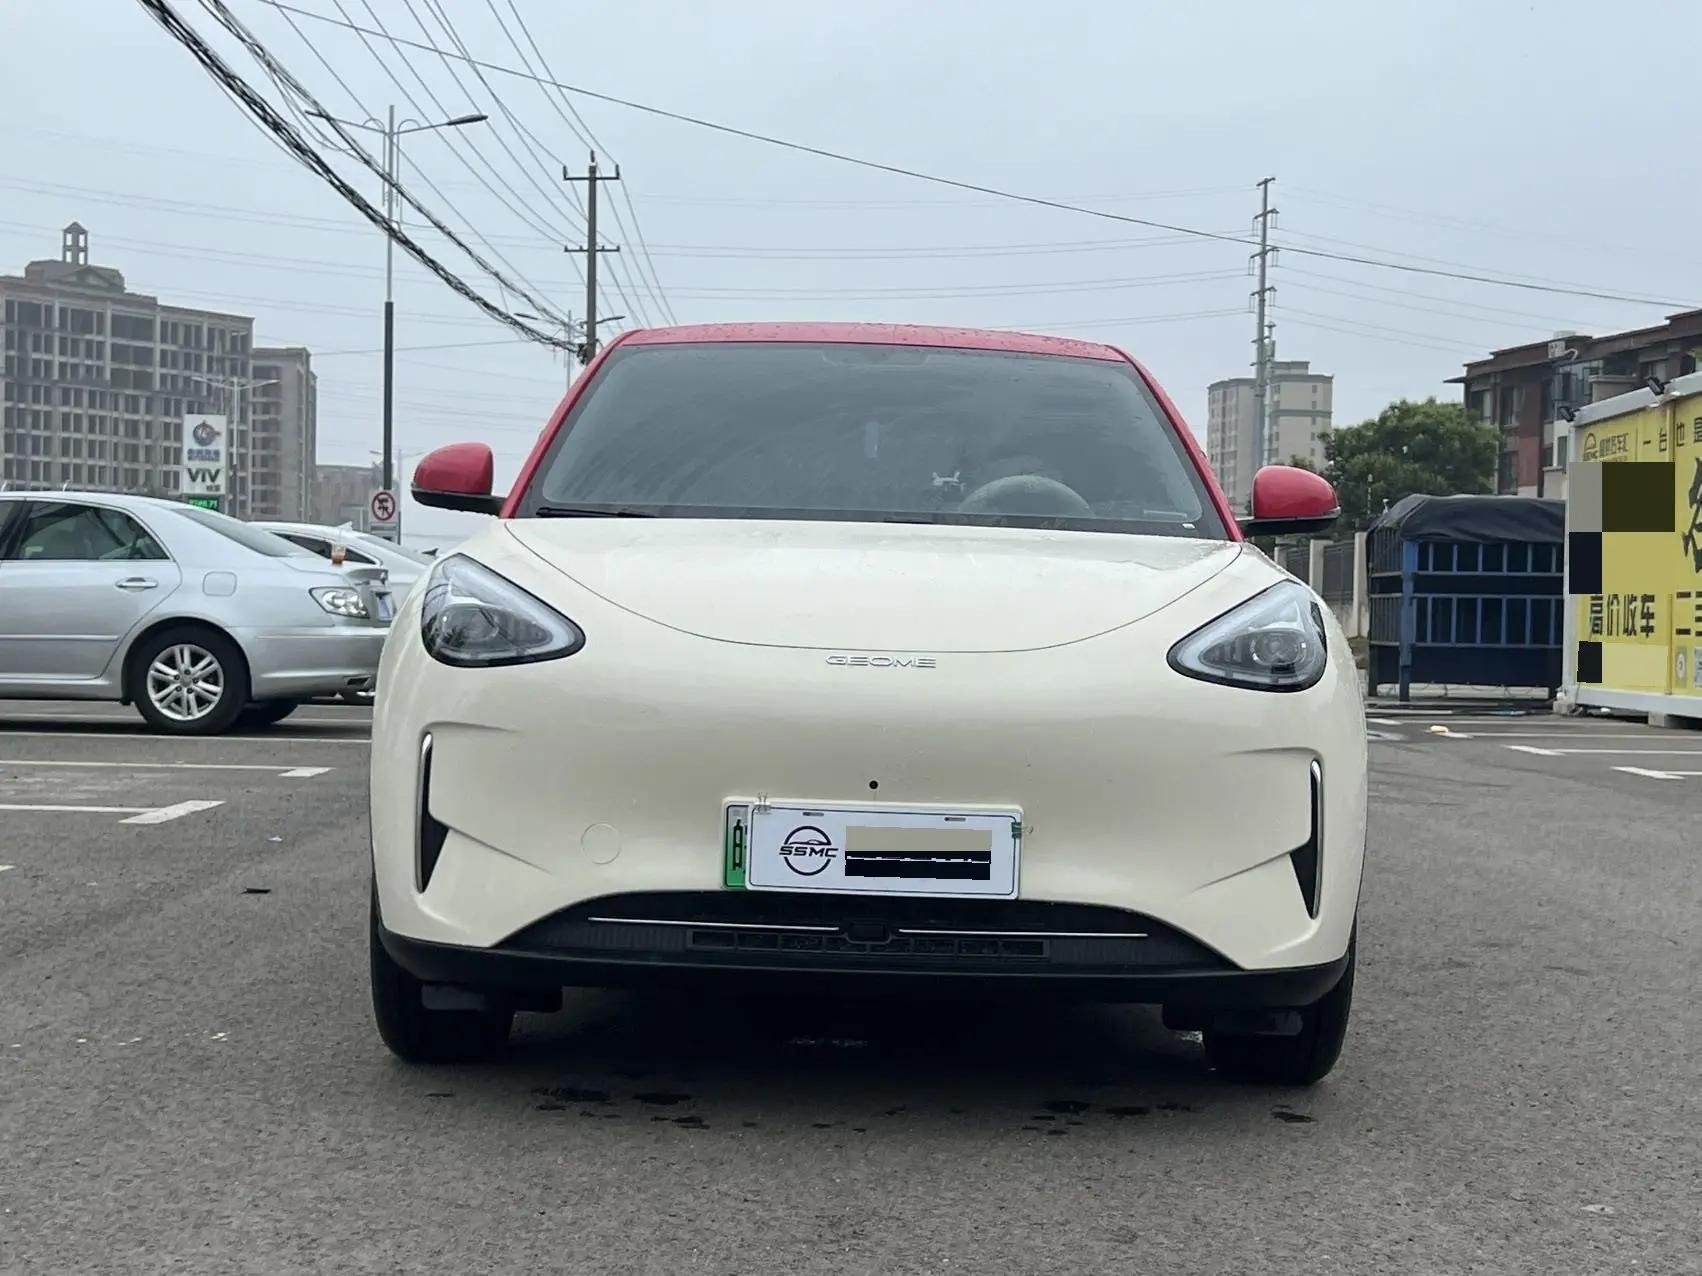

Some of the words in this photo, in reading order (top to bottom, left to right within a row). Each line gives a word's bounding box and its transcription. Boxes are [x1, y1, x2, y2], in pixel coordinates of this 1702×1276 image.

[1589, 594, 1655, 638] 高价收车
[825, 656, 936, 668] GEOME
[779, 845, 839, 858] SSMC
